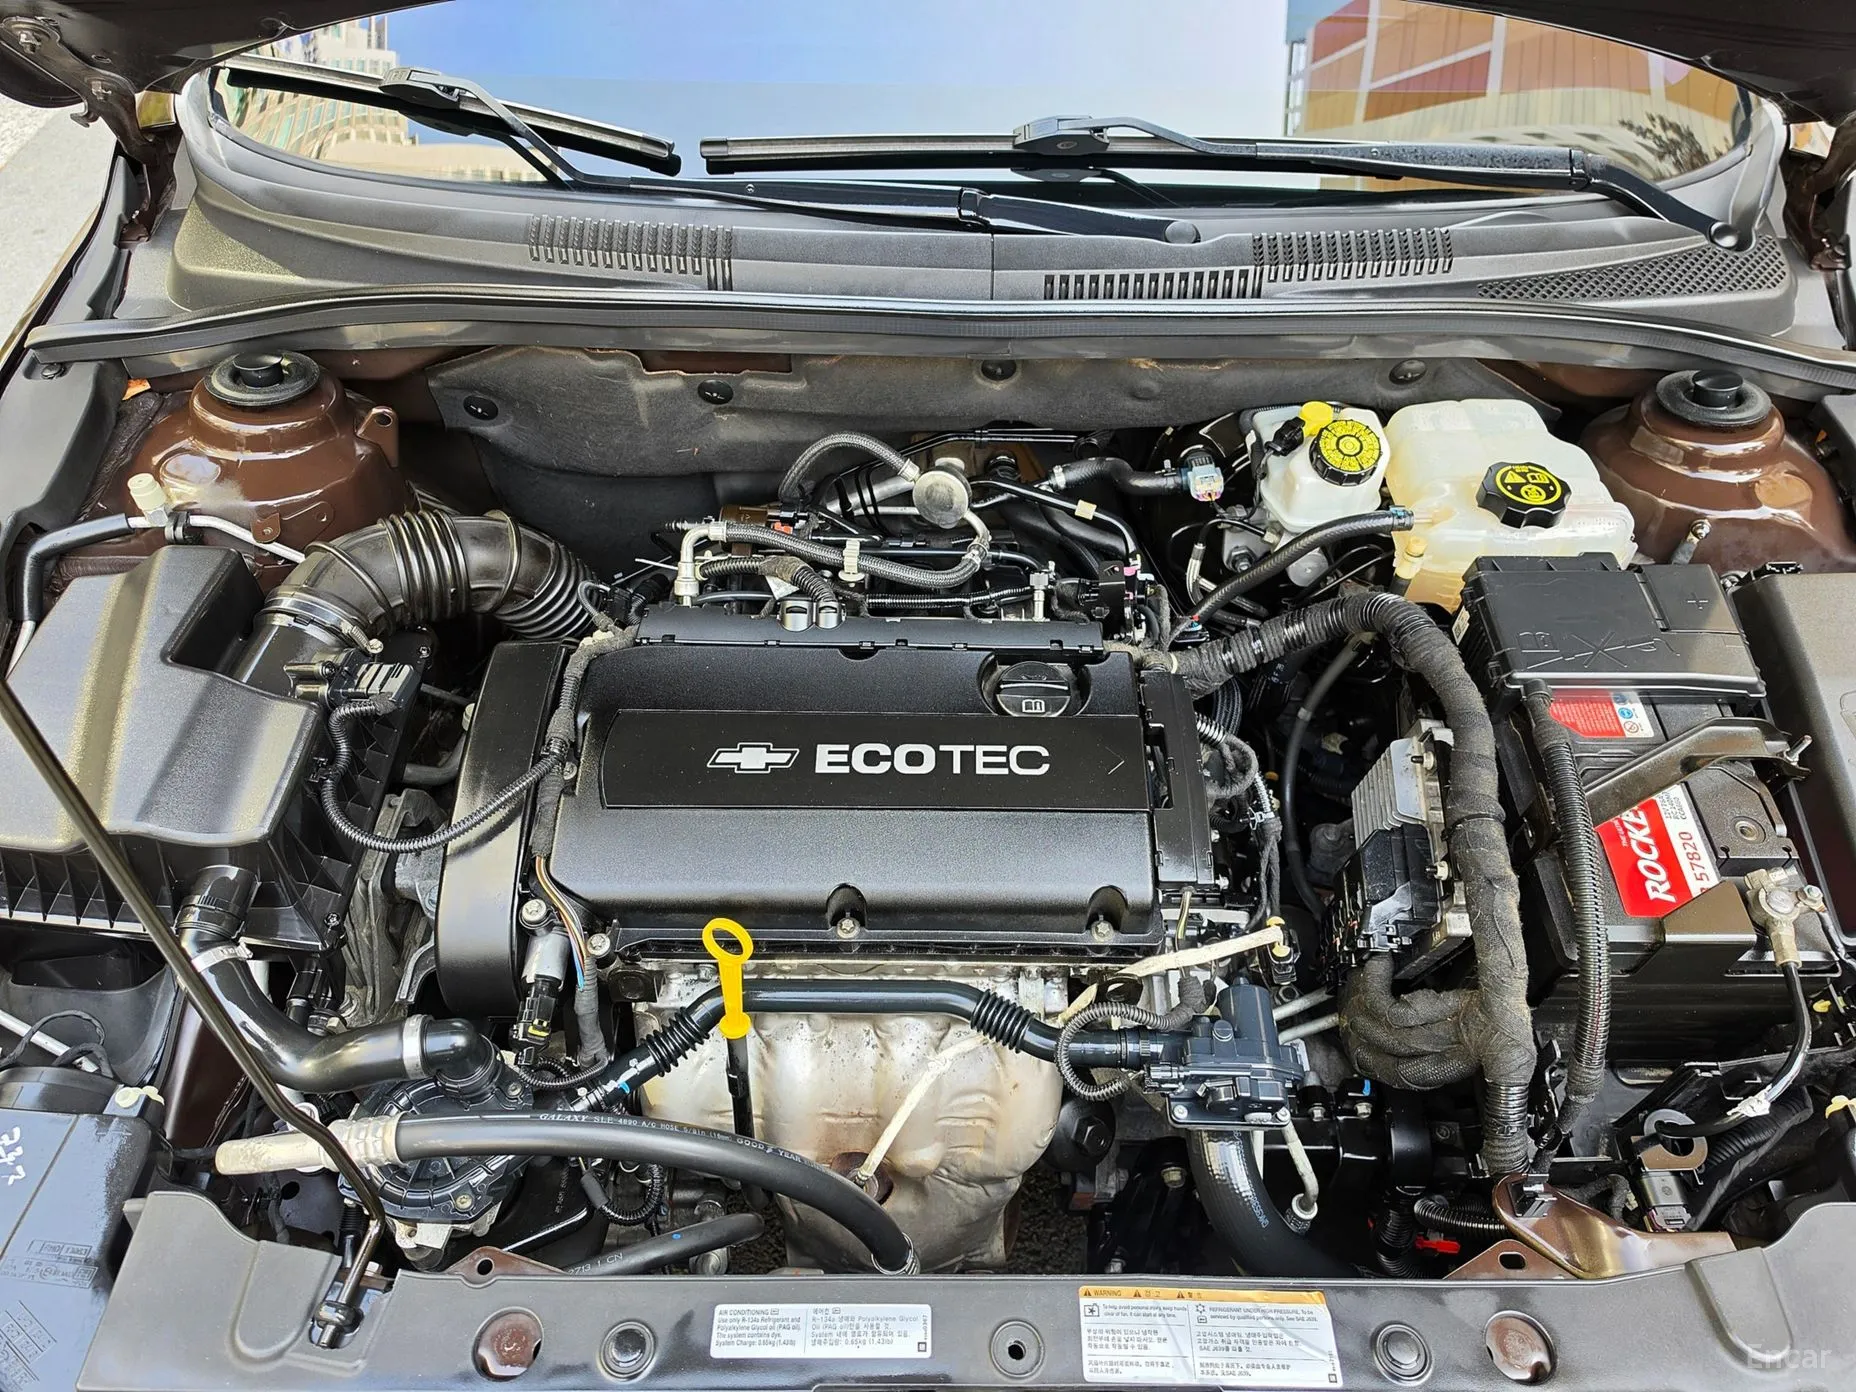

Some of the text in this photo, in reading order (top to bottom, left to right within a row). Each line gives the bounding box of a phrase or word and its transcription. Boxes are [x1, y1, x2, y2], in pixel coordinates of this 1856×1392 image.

[815, 743, 1050, 776] ECOTEC
[1621, 806, 1677, 903] ROCKE
[1678, 831, 1710, 882] 57820
[540, 1113, 589, 1122] GALAXY
[594, 1116, 614, 1124] SLE
[1094, 1289, 1122, 1297] WARNING
[730, 1316, 740, 1324] only
[761, 1316, 790, 1324] Refrigerant
